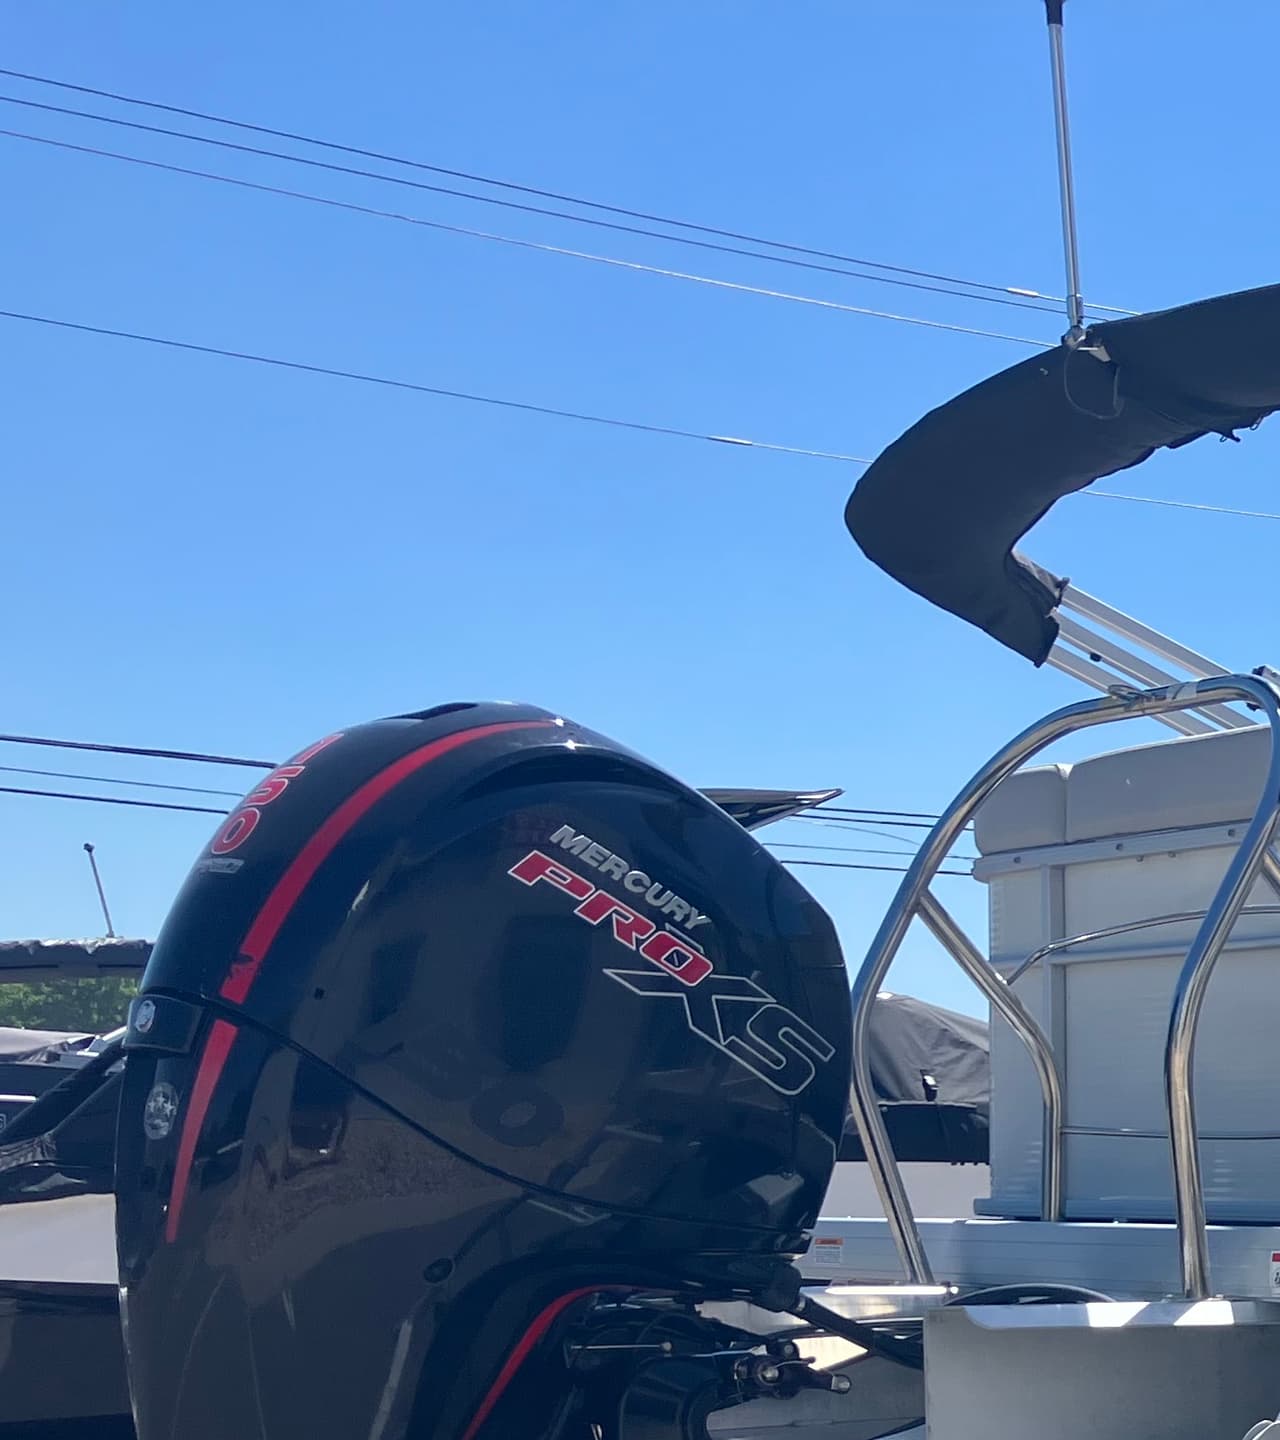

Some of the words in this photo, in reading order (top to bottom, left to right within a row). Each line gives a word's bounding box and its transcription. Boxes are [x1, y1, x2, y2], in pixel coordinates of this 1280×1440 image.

[507, 849, 714, 986] PRO
[549, 824, 712, 930] MERCURY
[602, 922, 836, 1095] XS
